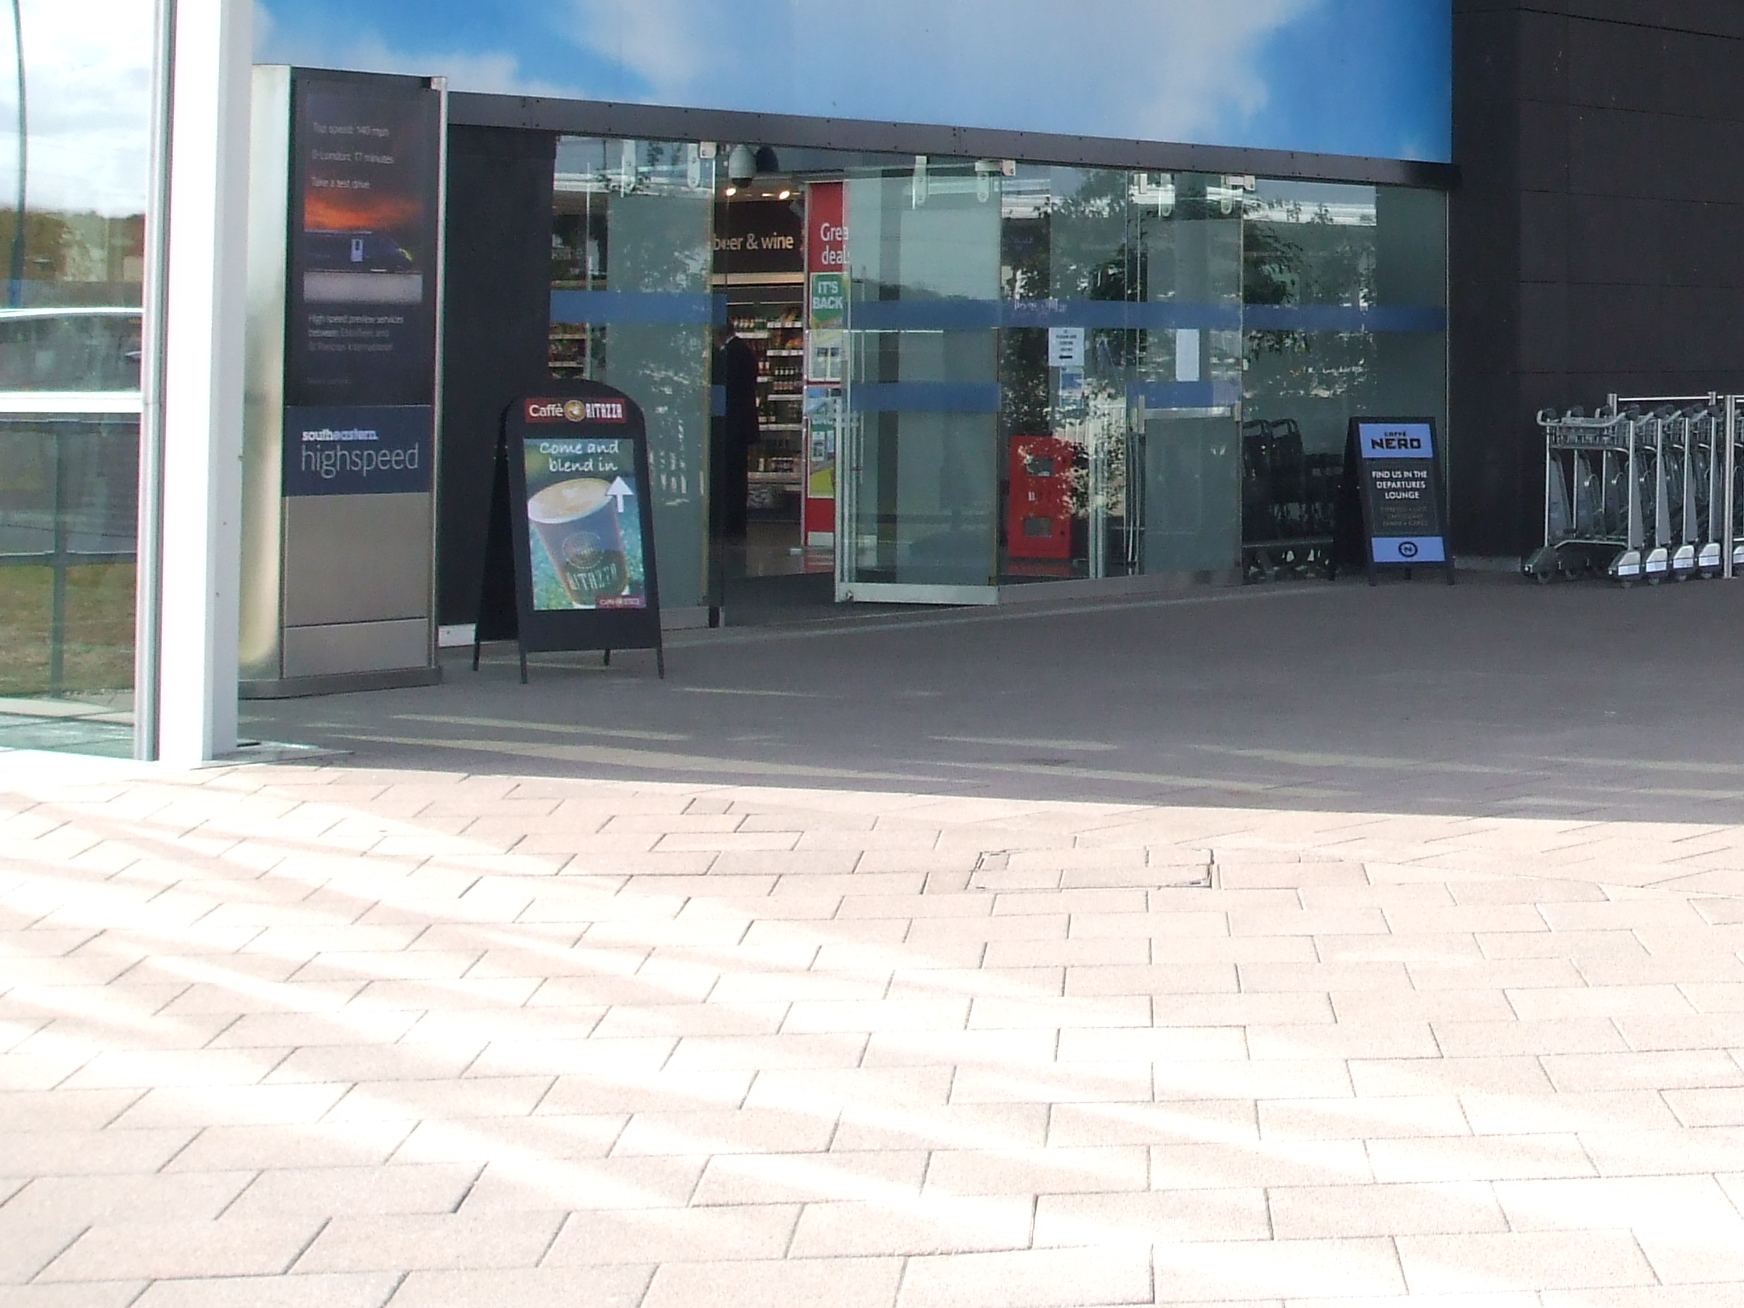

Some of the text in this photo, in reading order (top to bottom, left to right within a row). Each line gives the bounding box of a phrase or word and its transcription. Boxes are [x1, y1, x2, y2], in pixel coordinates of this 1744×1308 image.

[820, 222, 849, 242] Grea
[714, 232, 794, 251] beer & wine
[818, 281, 838, 295] IT'S
[813, 297, 843, 310] BACK
[585, 403, 623, 418] RITAZZA
[540, 440, 619, 454] Come and
[1371, 438, 1422, 450] NERO
[302, 442, 418, 478] highspeed
[549, 457, 618, 472] blend in
[1376, 481, 1426, 489] DEPARTURES
